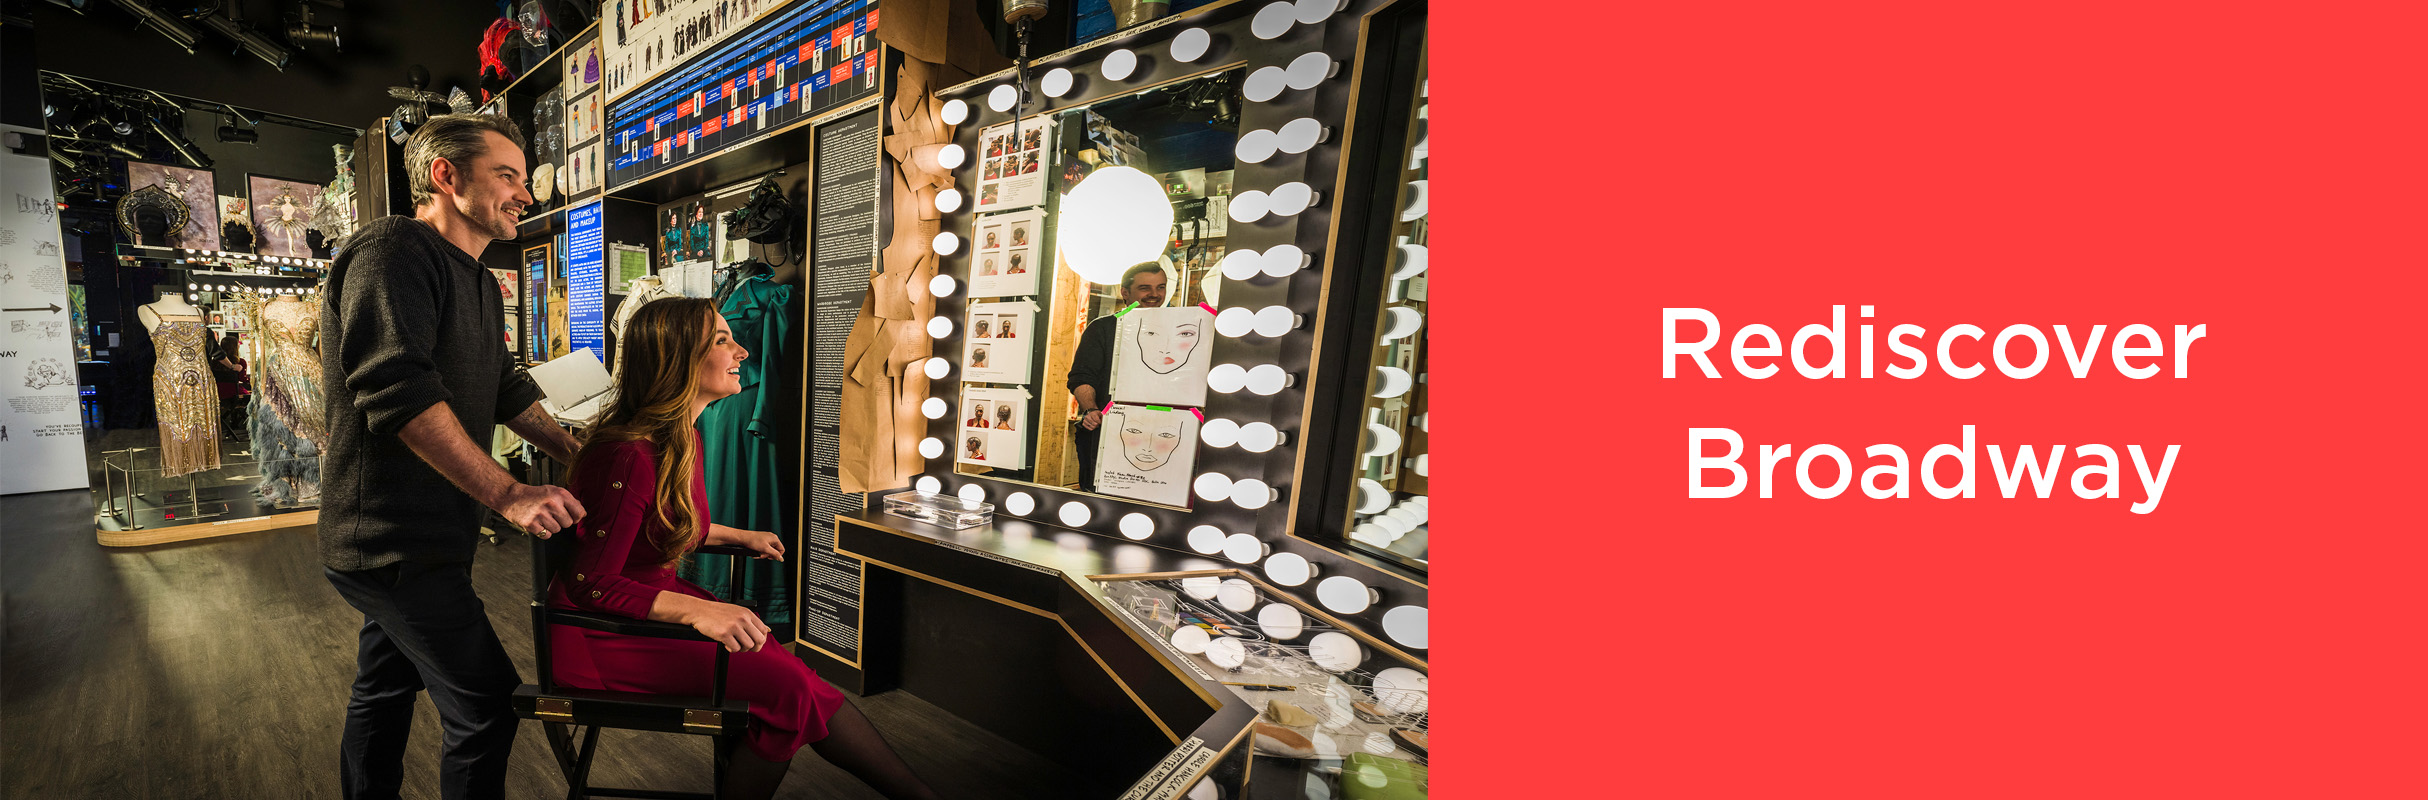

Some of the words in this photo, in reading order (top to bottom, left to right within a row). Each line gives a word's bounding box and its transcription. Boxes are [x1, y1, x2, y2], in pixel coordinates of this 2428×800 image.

[571, 209, 592, 221] COSTUMES,
[593, 205, 601, 214] HAI
[580, 216, 595, 226] MAKEUP
[1162, 750, 1184, 770] POTTER
[1190, 751, 1210, 768] CAROLE
[1151, 770, 1164, 782] AND
[1138, 780, 1153, 792] THE
